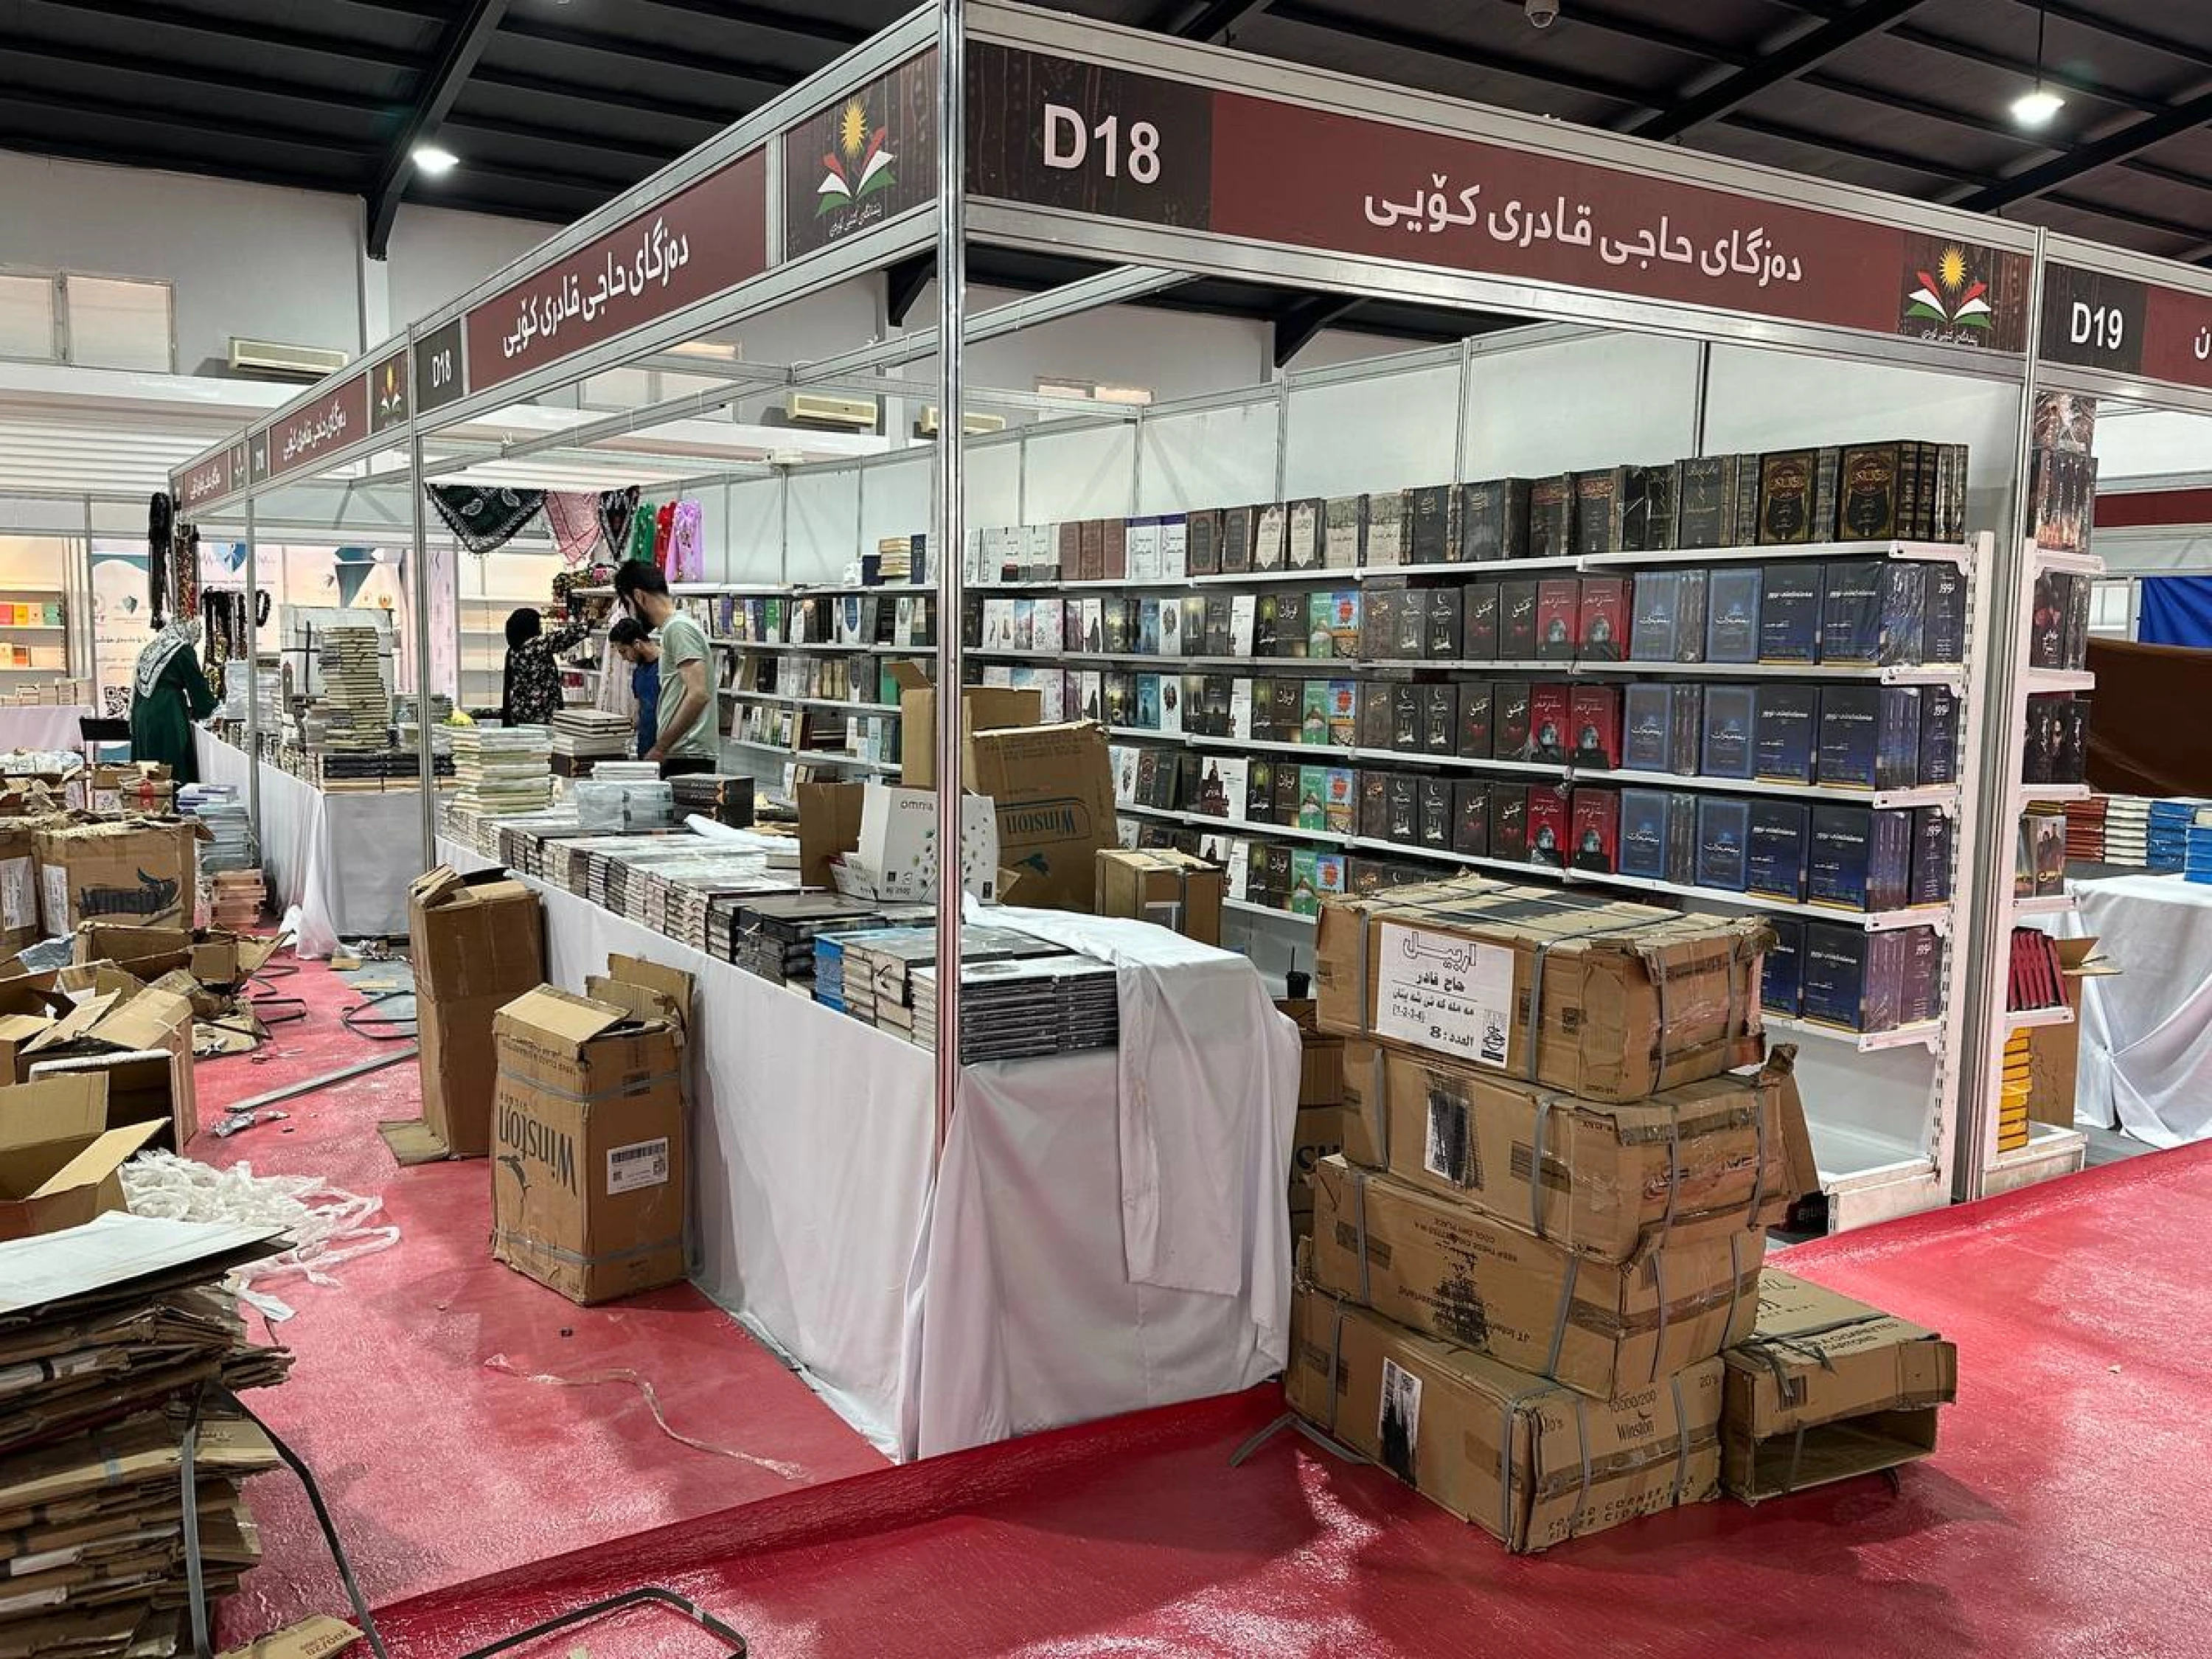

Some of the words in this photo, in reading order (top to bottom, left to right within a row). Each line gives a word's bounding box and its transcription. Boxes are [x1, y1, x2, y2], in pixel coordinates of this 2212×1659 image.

[1043, 102, 1161, 184] D18
[1487, 196, 1593, 248] قادری
[1599, 216, 1693, 269] حاجی
[2070, 302, 2124, 350] D19
[432, 349, 453, 388] D18
[498, 1105, 577, 1198] Winston
